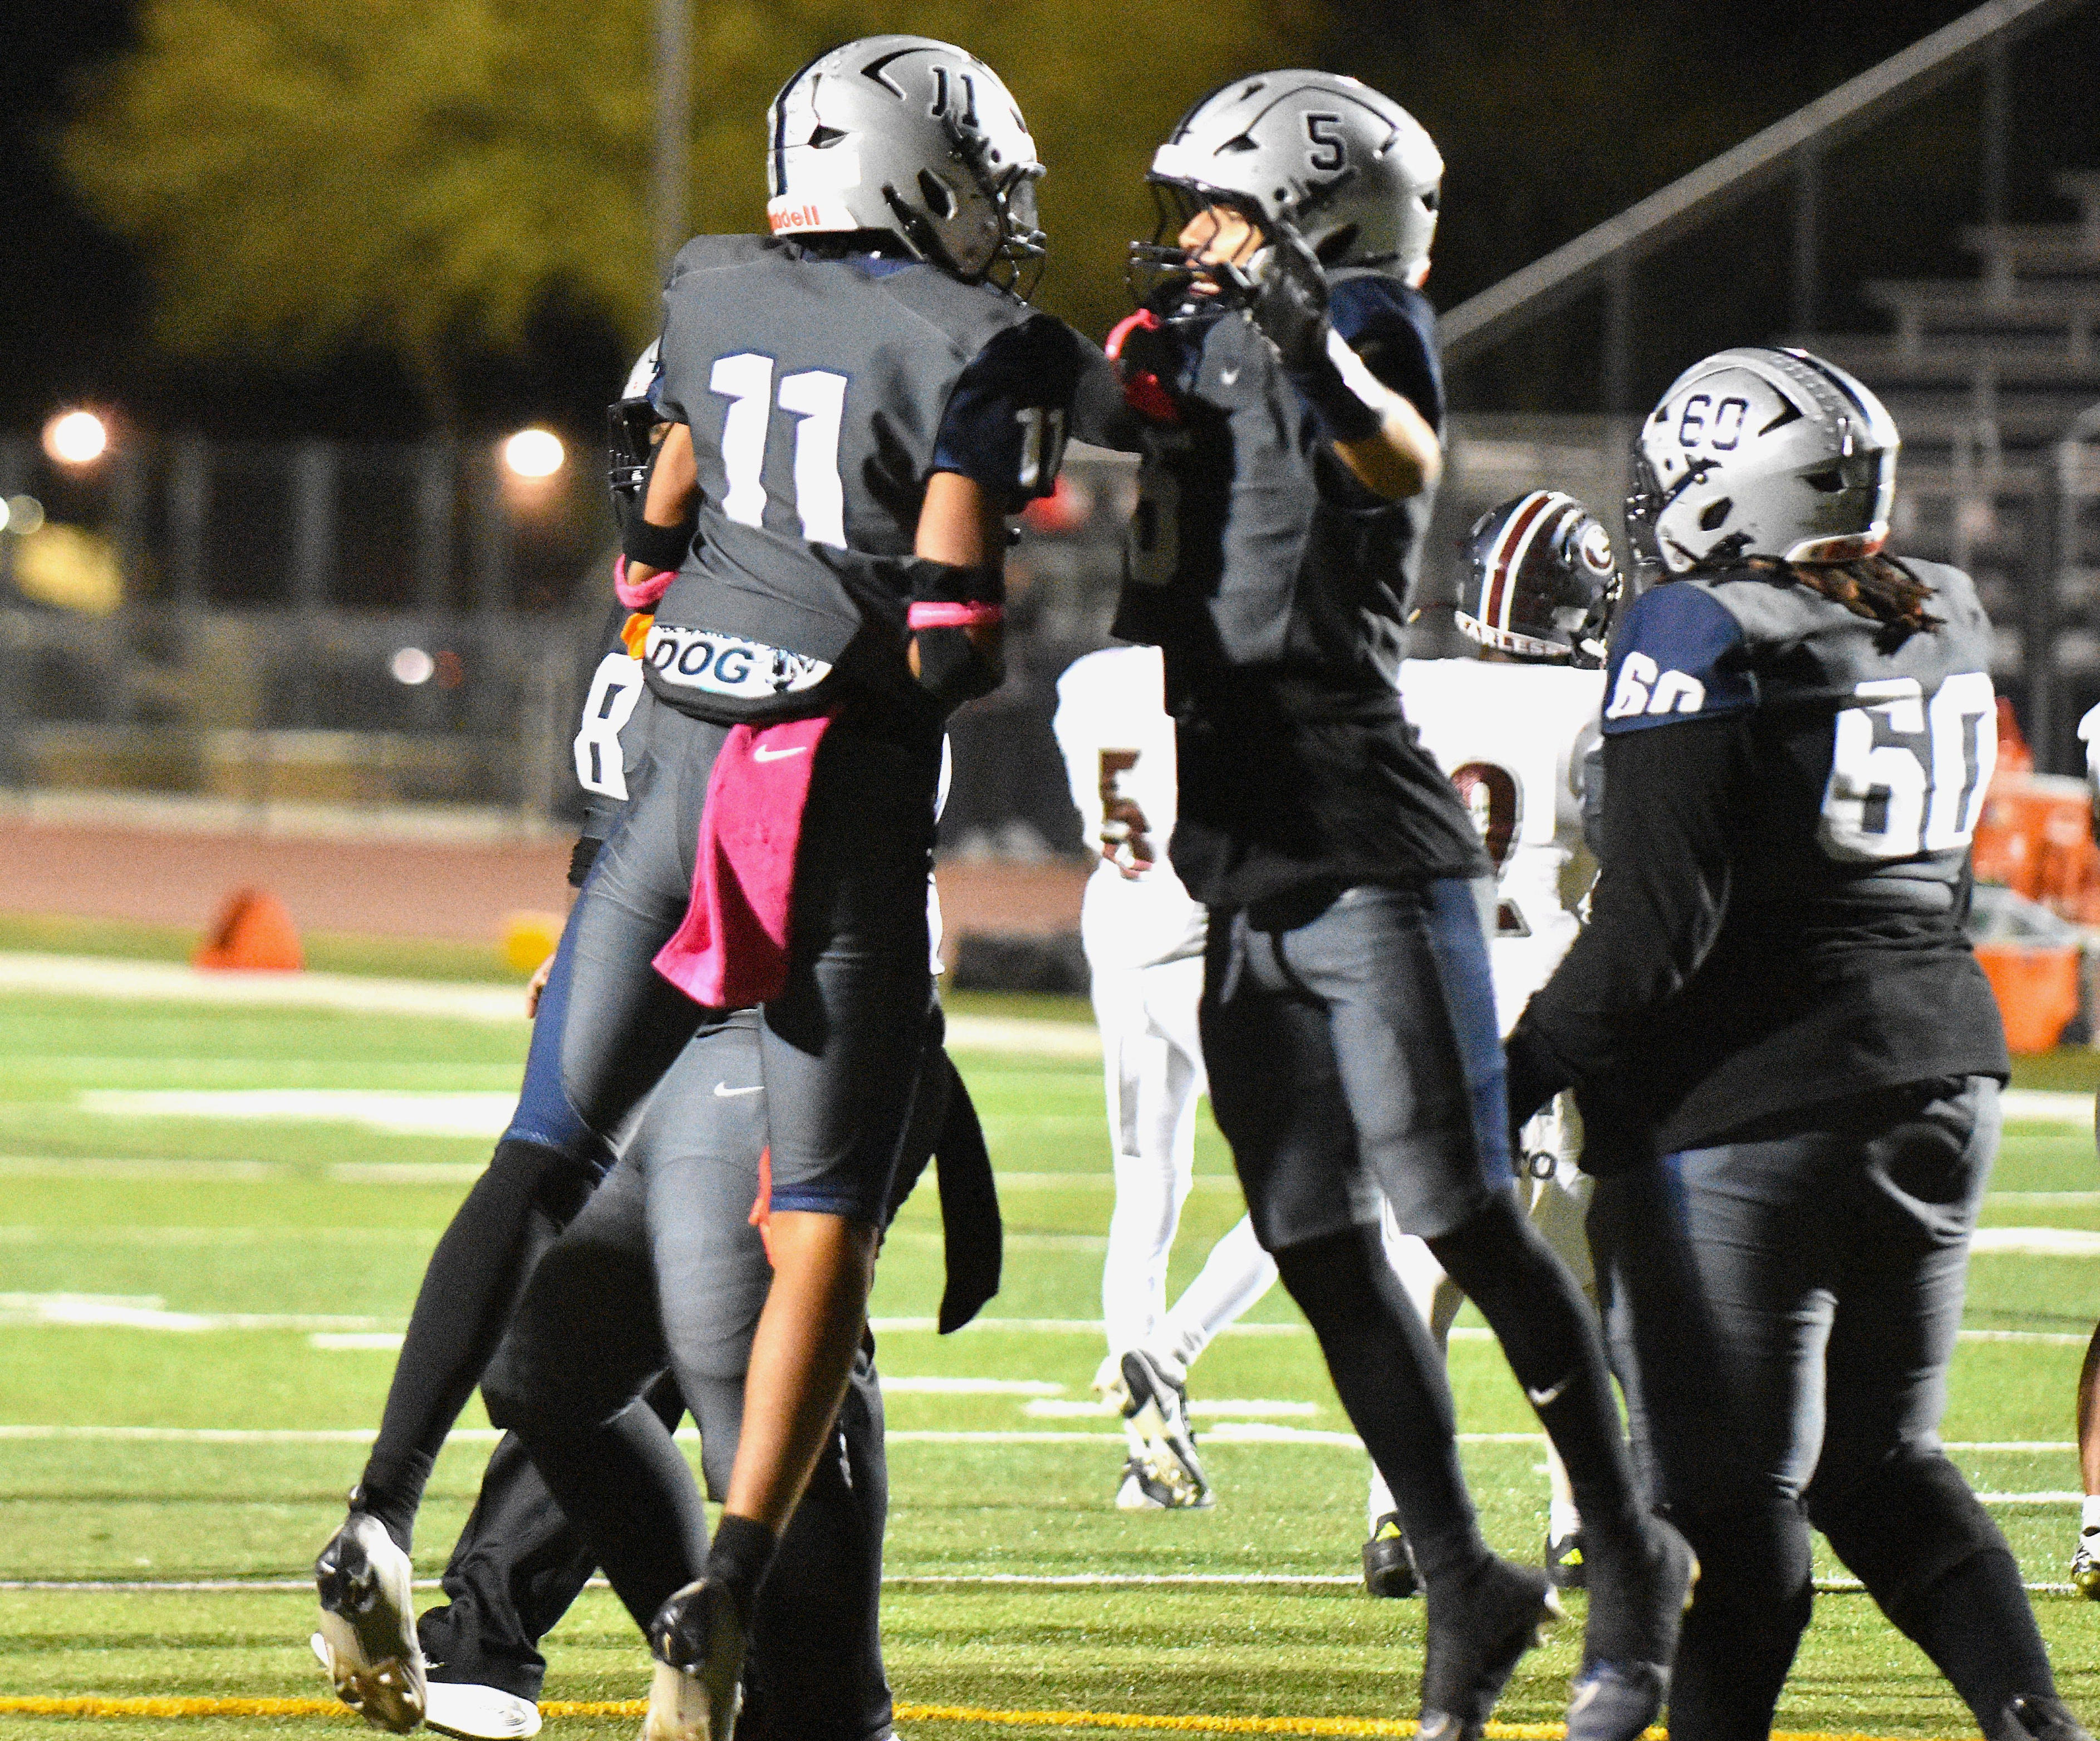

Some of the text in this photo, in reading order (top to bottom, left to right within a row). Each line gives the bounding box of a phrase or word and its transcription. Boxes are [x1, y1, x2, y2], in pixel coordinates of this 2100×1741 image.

[931, 65, 979, 129] 11
[1306, 113, 1345, 171] 5
[710, 352, 848, 549] 11
[1015, 407, 1064, 488] 11
[1678, 393, 1749, 451] 60
[651, 637, 756, 685] DOG
[1605, 651, 1706, 719] 60
[573, 652, 645, 801] 8
[1818, 671, 1998, 858] 60
[1098, 747, 1156, 882] 5
